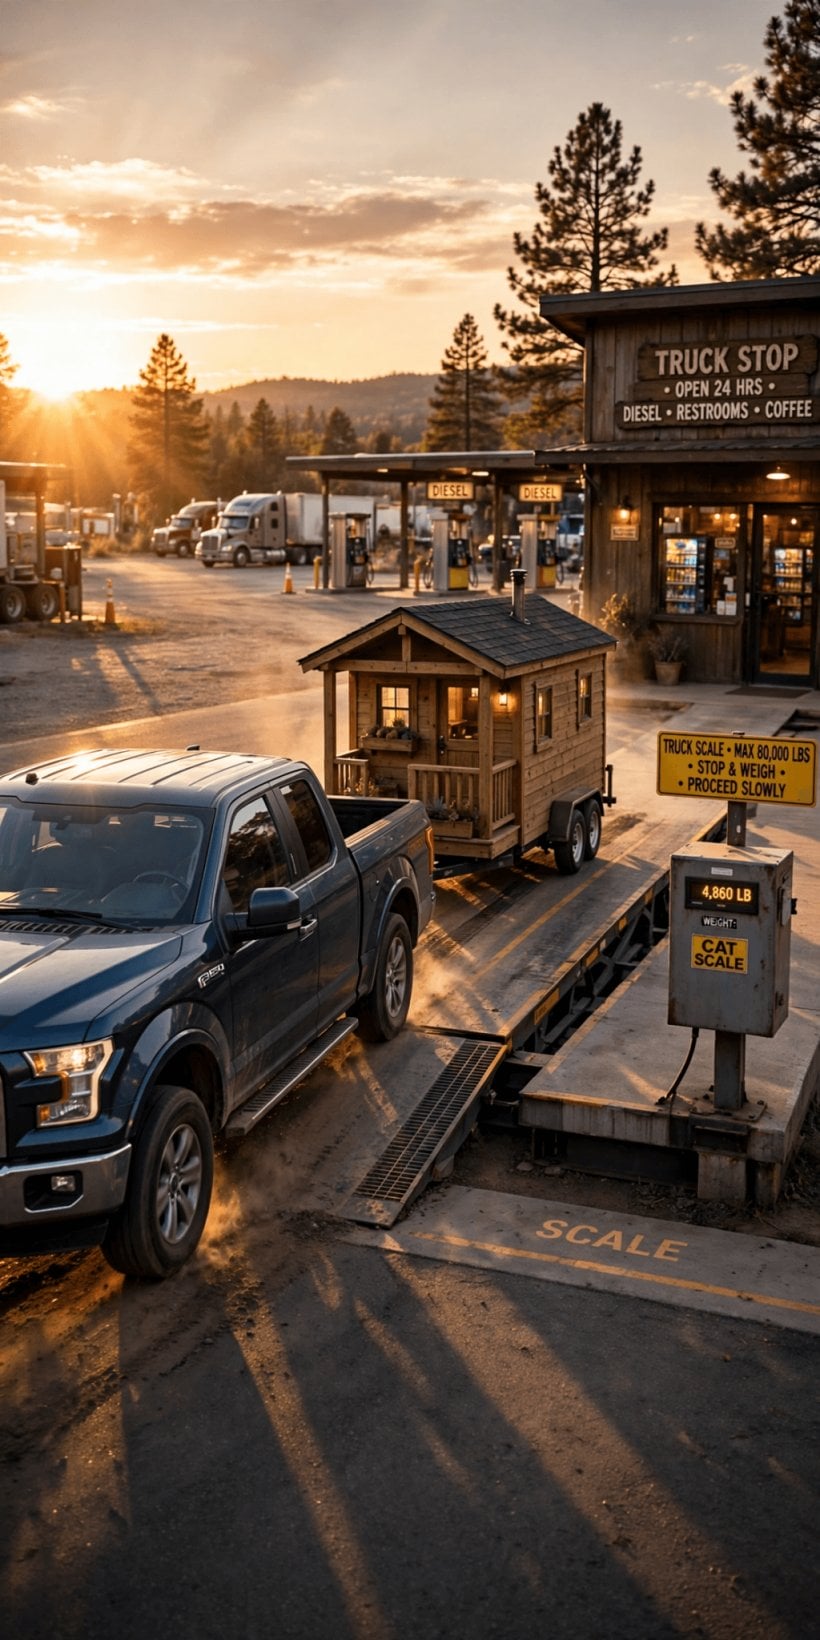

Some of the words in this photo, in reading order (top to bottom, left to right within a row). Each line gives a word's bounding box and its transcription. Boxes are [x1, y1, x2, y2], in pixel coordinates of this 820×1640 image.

[655, 346, 729, 376] TRUCK
[737, 343, 799, 372] STOP
[675, 380, 710, 397] OPEN
[714, 379, 731, 396] 24
[736, 378, 763, 396] HRS
[623, 404, 662, 422] DIESEL
[676, 402, 749, 420] RESTROOMS
[765, 400, 812, 418] COFFEE
[432, 484, 468, 497] DIESEL
[524, 487, 556, 499] DIESEL
[663, 738, 693, 755] TRUCK
[696, 740, 724, 757] SCALE
[734, 743, 754, 758] MAX
[757, 745, 789, 762] 80,000
[792, 747, 810, 763] LBS
[698, 760, 725, 775] STOP
[729, 762, 736, 776] &
[740, 763, 775, 779] WEIGH
[688, 777, 738, 794] PROCEED
[742, 781, 786, 798] SLOWLY
[702, 885, 733, 900] 4,860
[737, 888, 751, 902] LB
[701, 939, 737, 956] CAT
[694, 953, 744, 970] SCALE
[535, 1219, 688, 1262] SCALE
